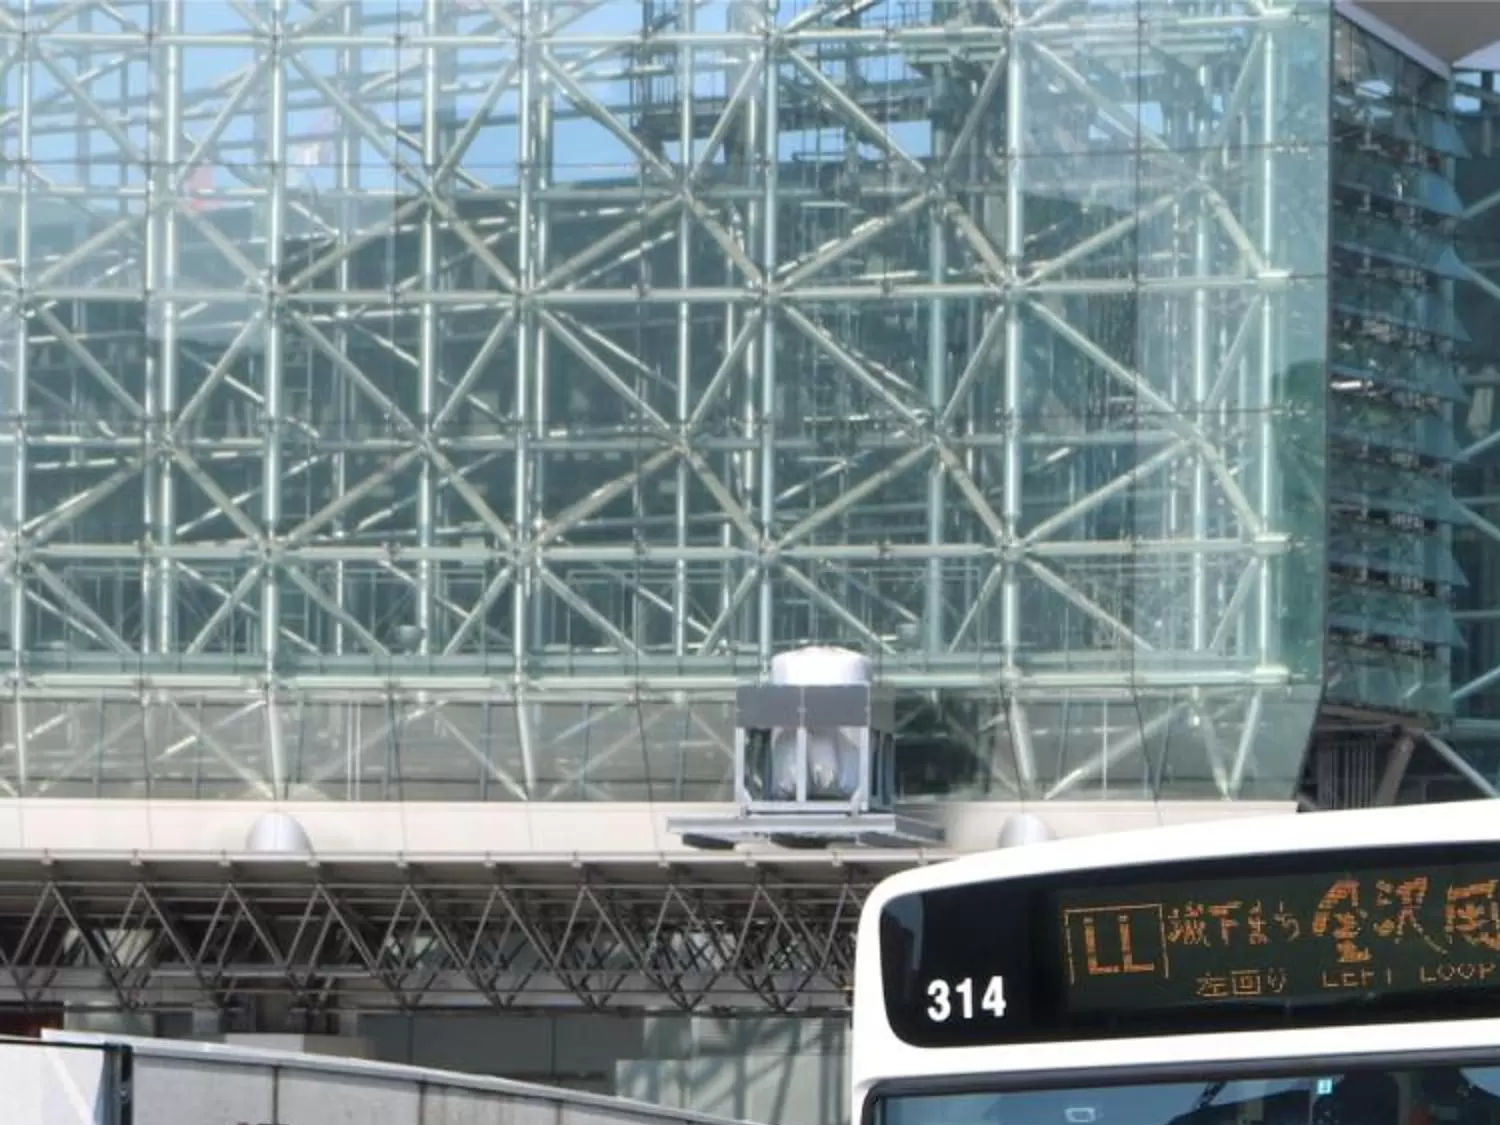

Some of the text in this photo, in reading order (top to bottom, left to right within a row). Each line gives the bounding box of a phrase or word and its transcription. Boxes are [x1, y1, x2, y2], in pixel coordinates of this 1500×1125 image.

[927, 975, 1006, 1022] 314
[1196, 967, 1288, 997] 左回り
[1420, 963, 1496, 984] LOOP
